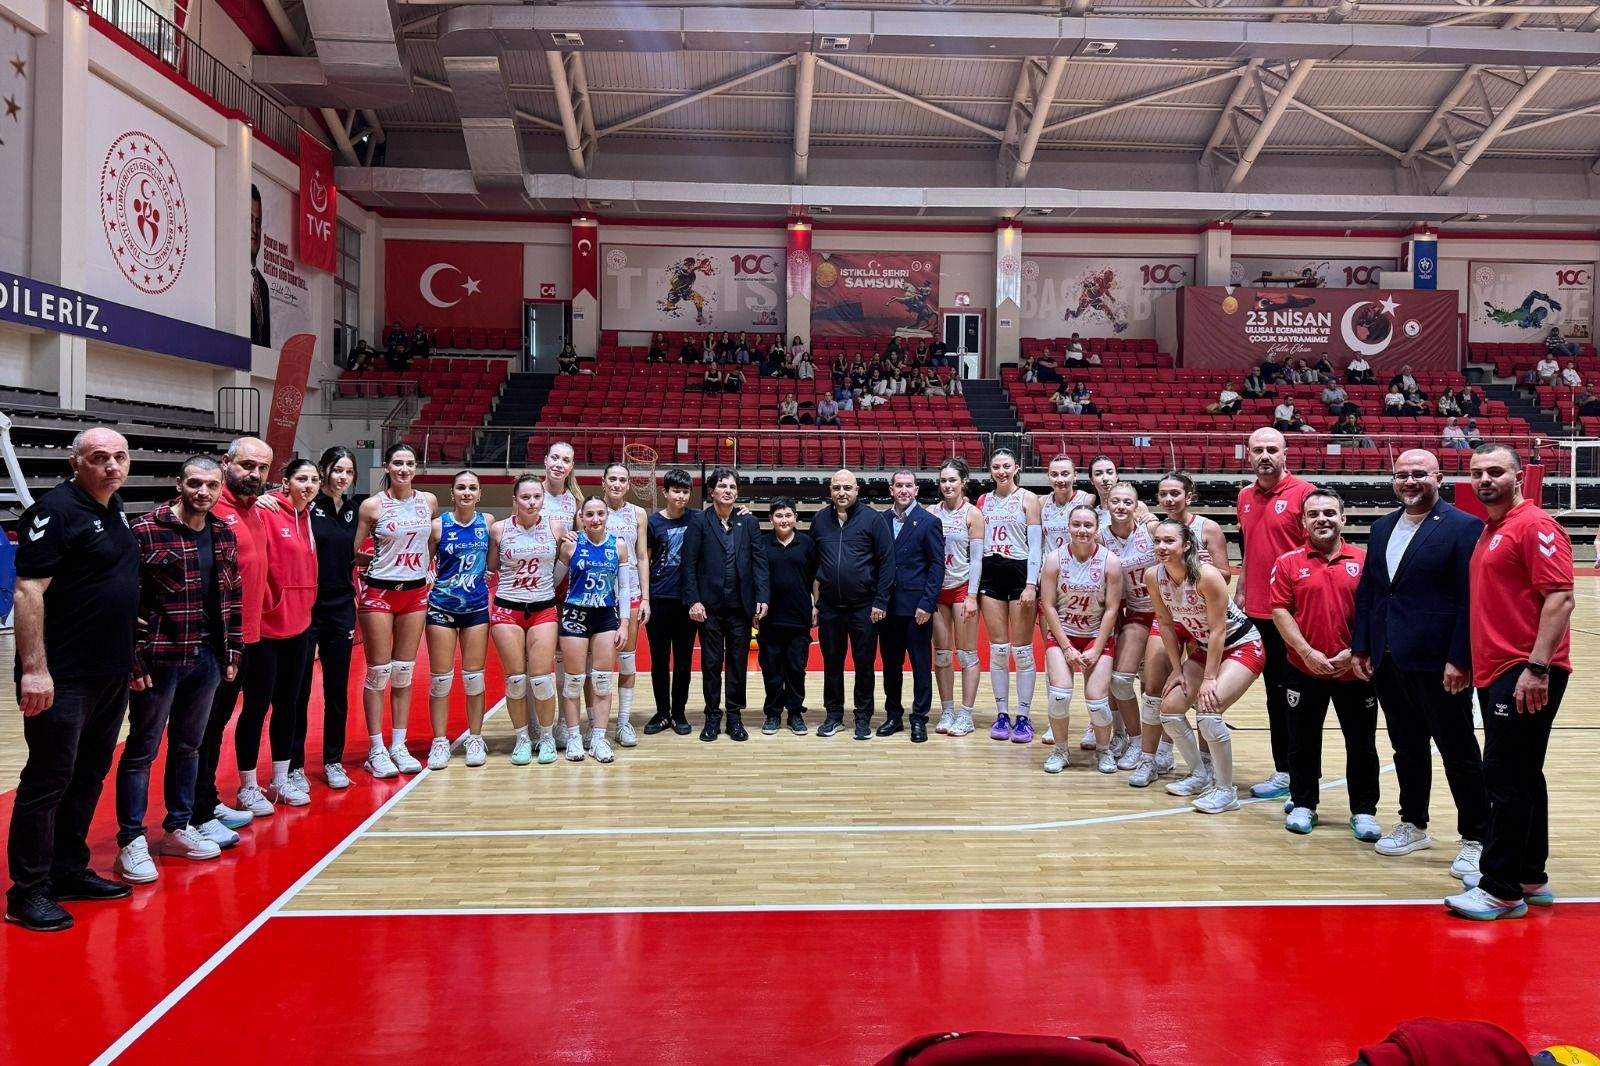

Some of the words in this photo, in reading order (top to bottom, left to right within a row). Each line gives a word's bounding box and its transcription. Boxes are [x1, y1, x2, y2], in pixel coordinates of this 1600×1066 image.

[306, 213, 331, 241] TVF
[541, 286, 555, 296] C4
[844, 277, 905, 289] SAMSUN
[1246, 311, 1268, 326] 23
[1273, 309, 1332, 327] NİSAN
[1245, 326, 1274, 334] ULUSAL
[1275, 326, 1319, 335] EGEMENLİK
[1320, 327, 1331, 335] VE
[1248, 335, 1277, 343] ÇOCUK
[1278, 335, 1328, 343] BAYRAMIMIZ
[406, 531, 417, 550] 7
[992, 526, 1008, 541] 16
[454, 541, 488, 549] KESKIN
[459, 553, 477, 573] 19
[516, 558, 540, 575] 26
[584, 572, 608, 590] 55
[1128, 567, 1145, 586] 17
[1068, 595, 1090, 612] 24
[570, 609, 587, 622] 55
